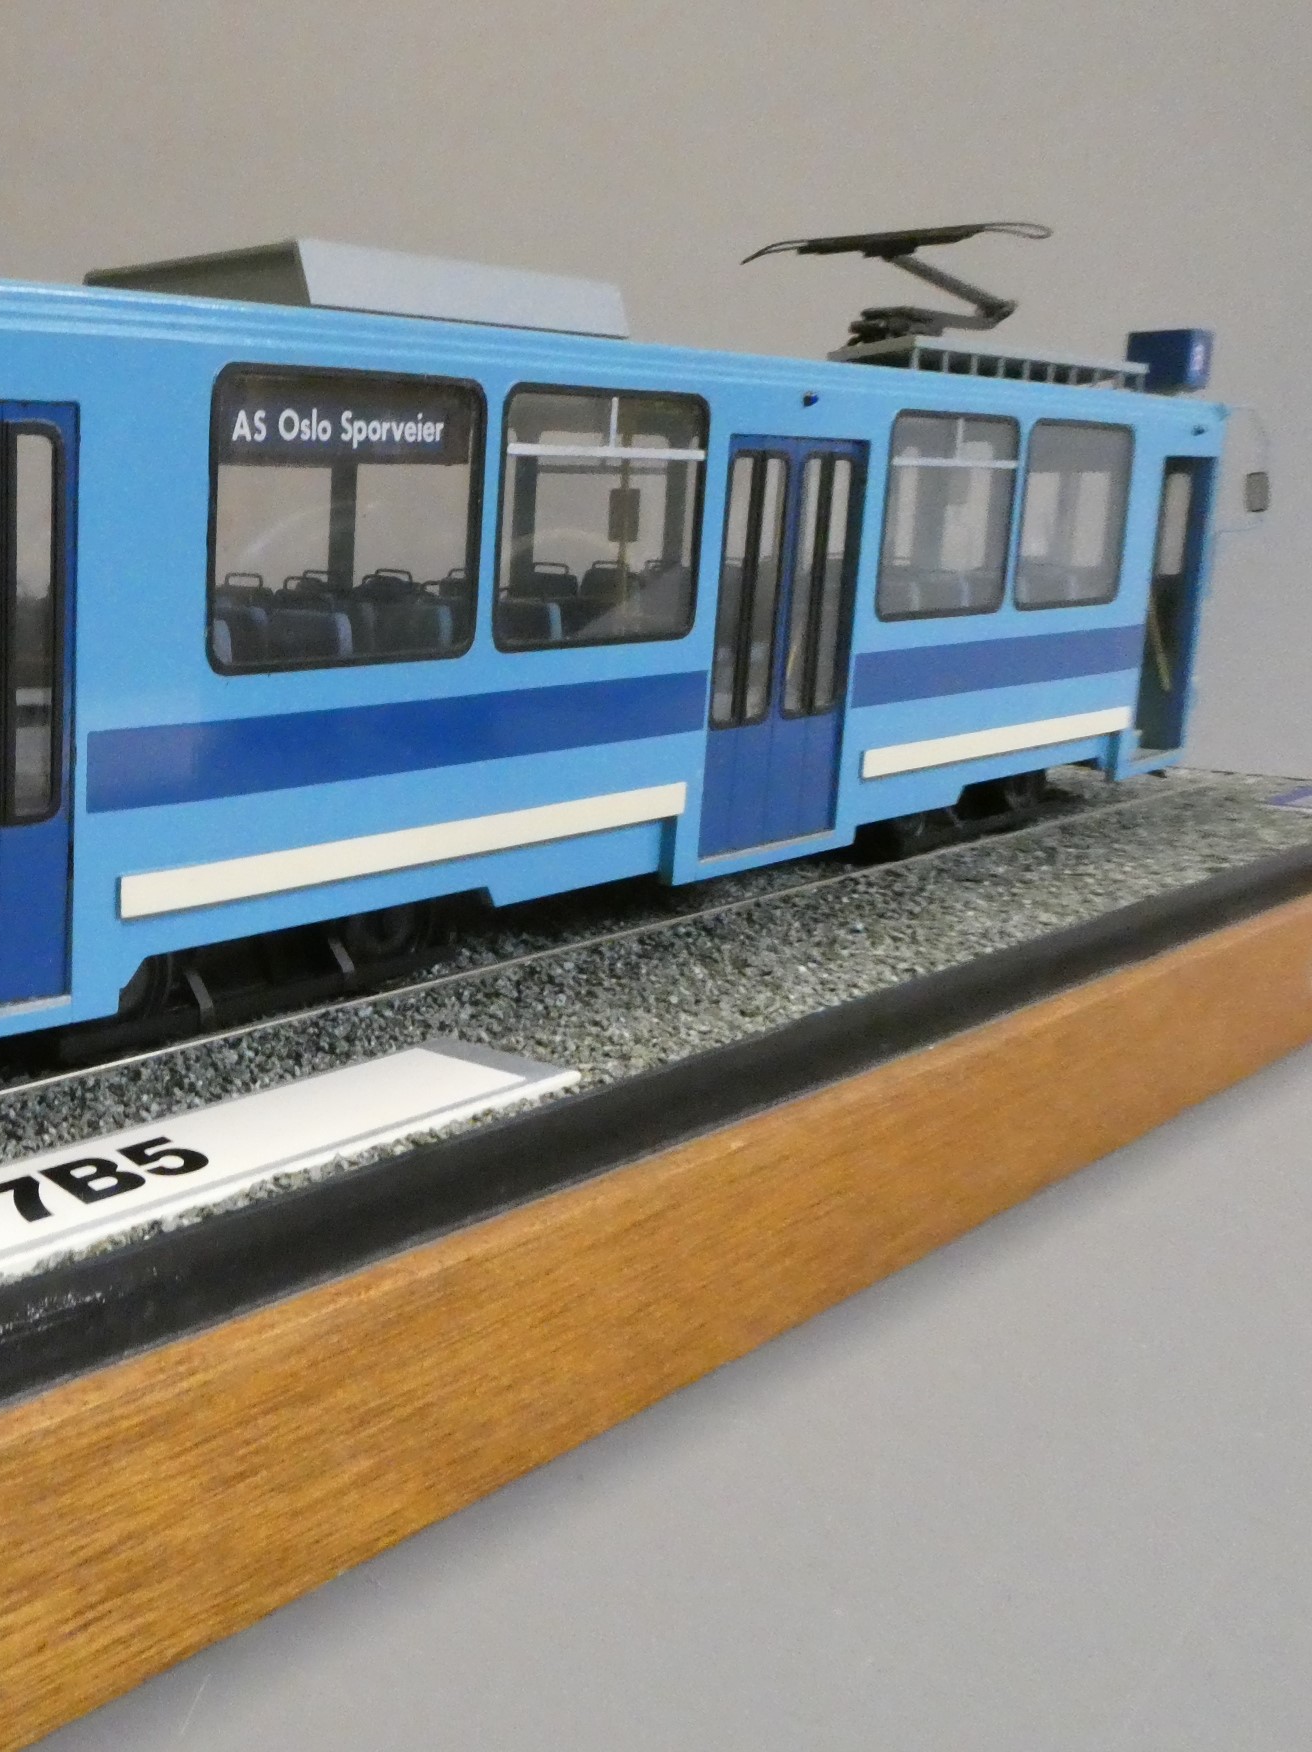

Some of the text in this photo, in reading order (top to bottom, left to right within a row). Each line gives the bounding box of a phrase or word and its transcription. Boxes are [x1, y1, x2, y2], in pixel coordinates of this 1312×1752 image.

[232, 407, 445, 449] AS Oslo Sporveier
